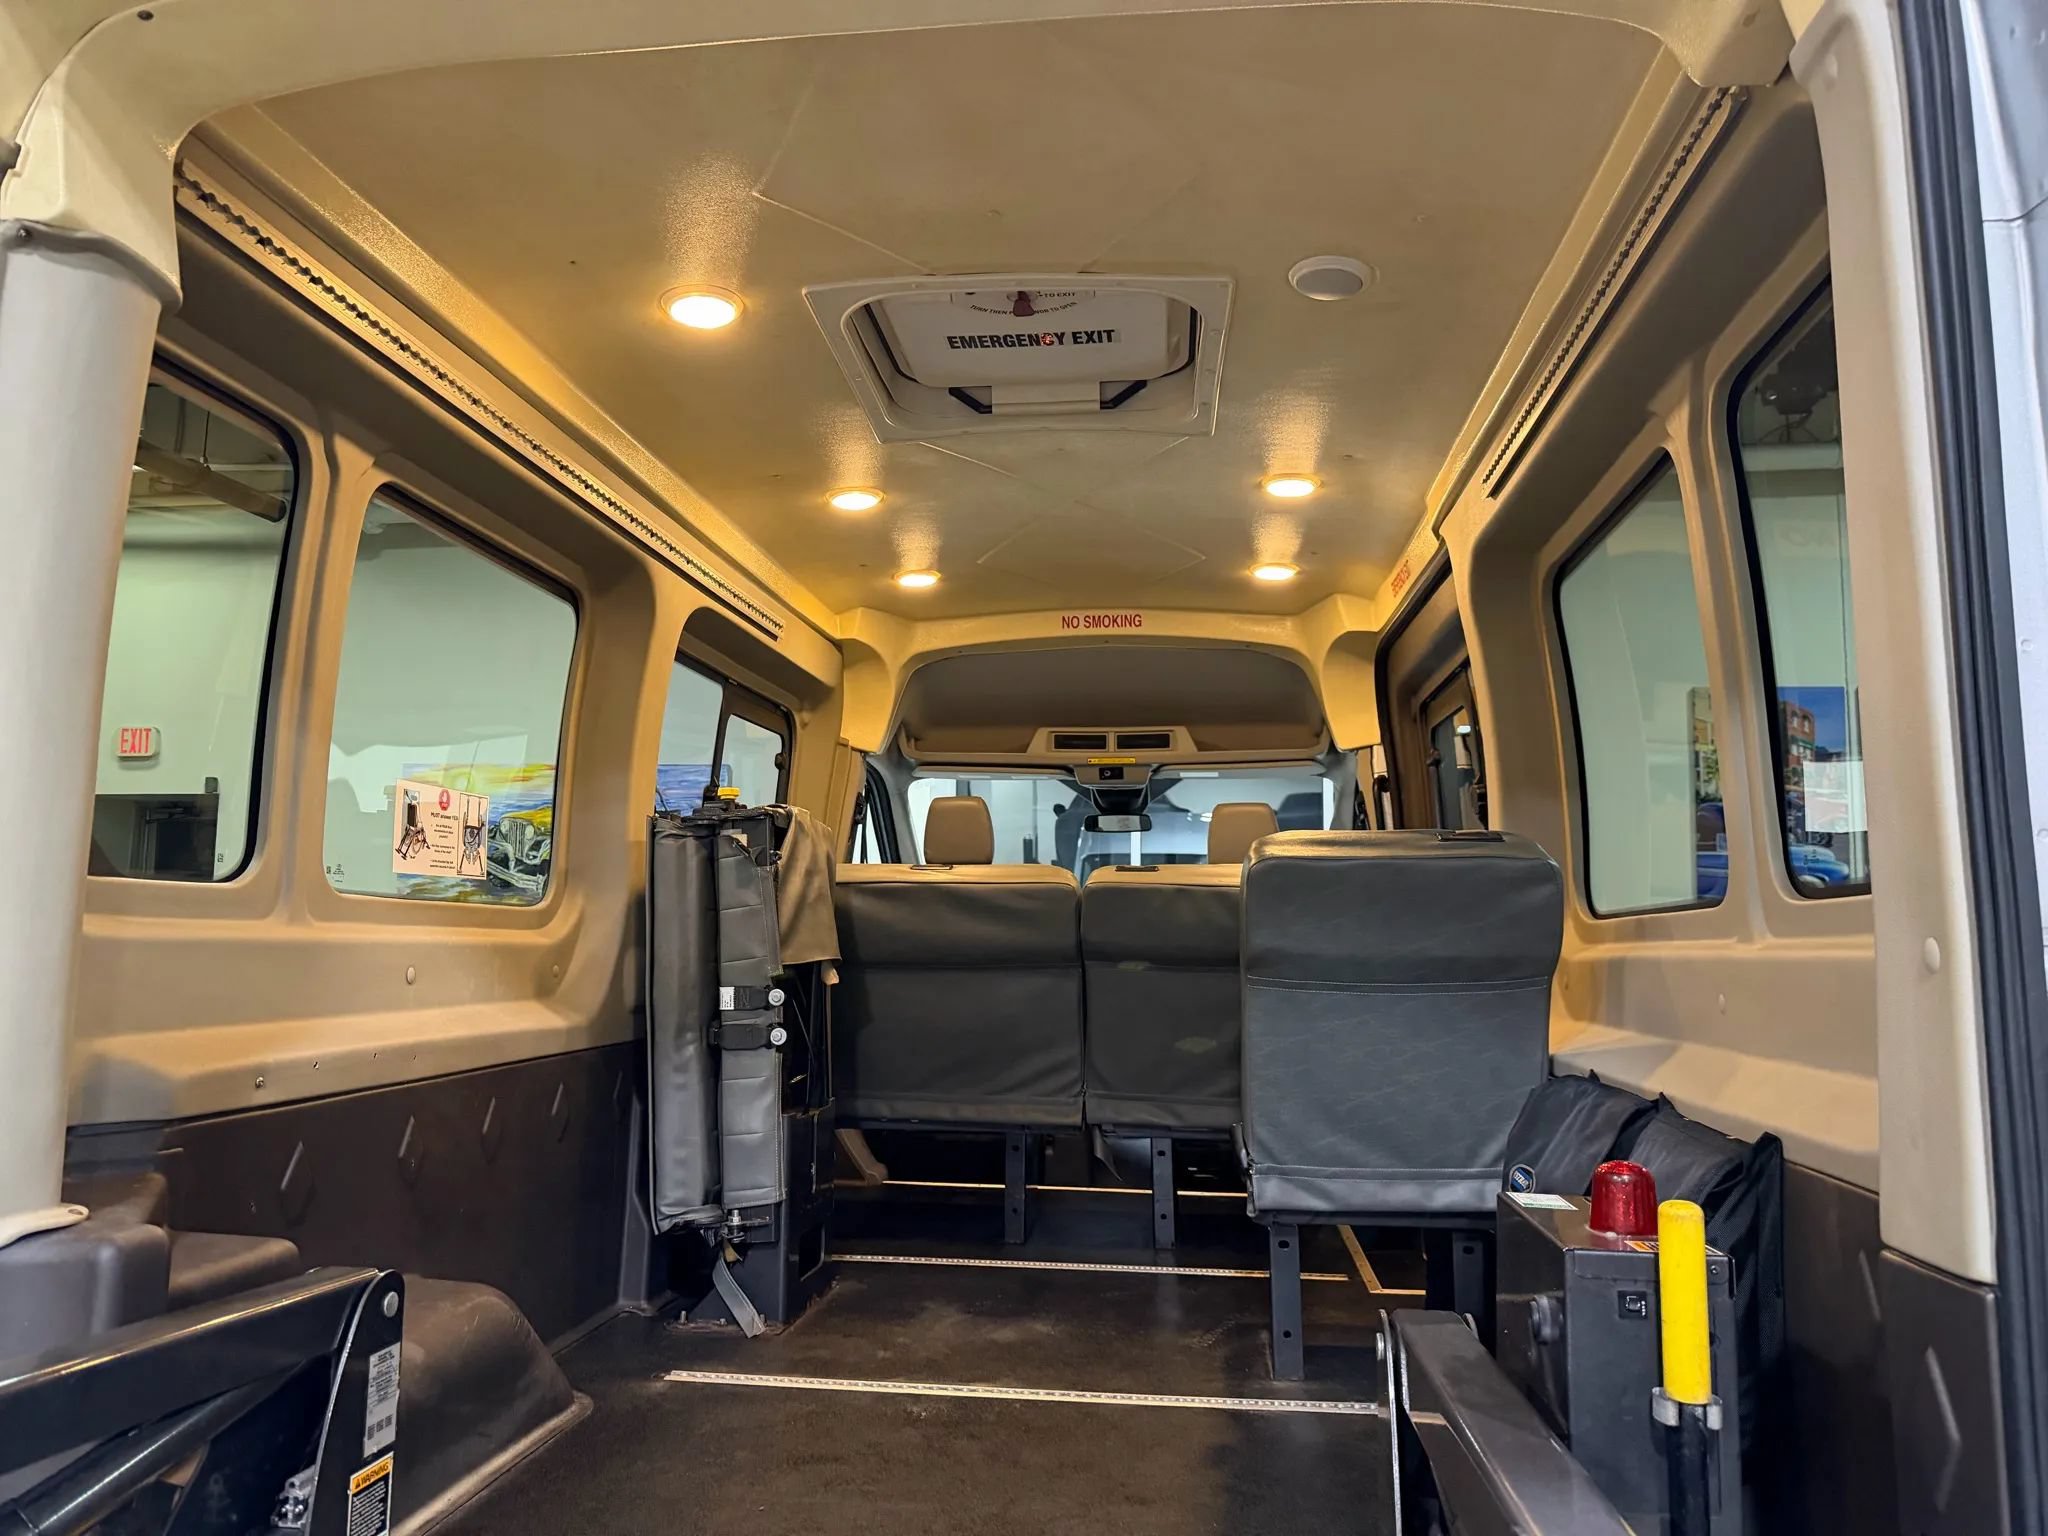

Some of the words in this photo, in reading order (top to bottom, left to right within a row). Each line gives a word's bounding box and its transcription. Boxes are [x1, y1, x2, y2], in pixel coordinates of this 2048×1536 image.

[947, 331, 1065, 350] EMERGENCY
[1072, 329, 1116, 345] EXIT
[1062, 615, 1080, 629] NO
[1083, 614, 1142, 629] SMOKING
[120, 728, 152, 753] EXIT
[360, 1462, 389, 1488] WARNING
